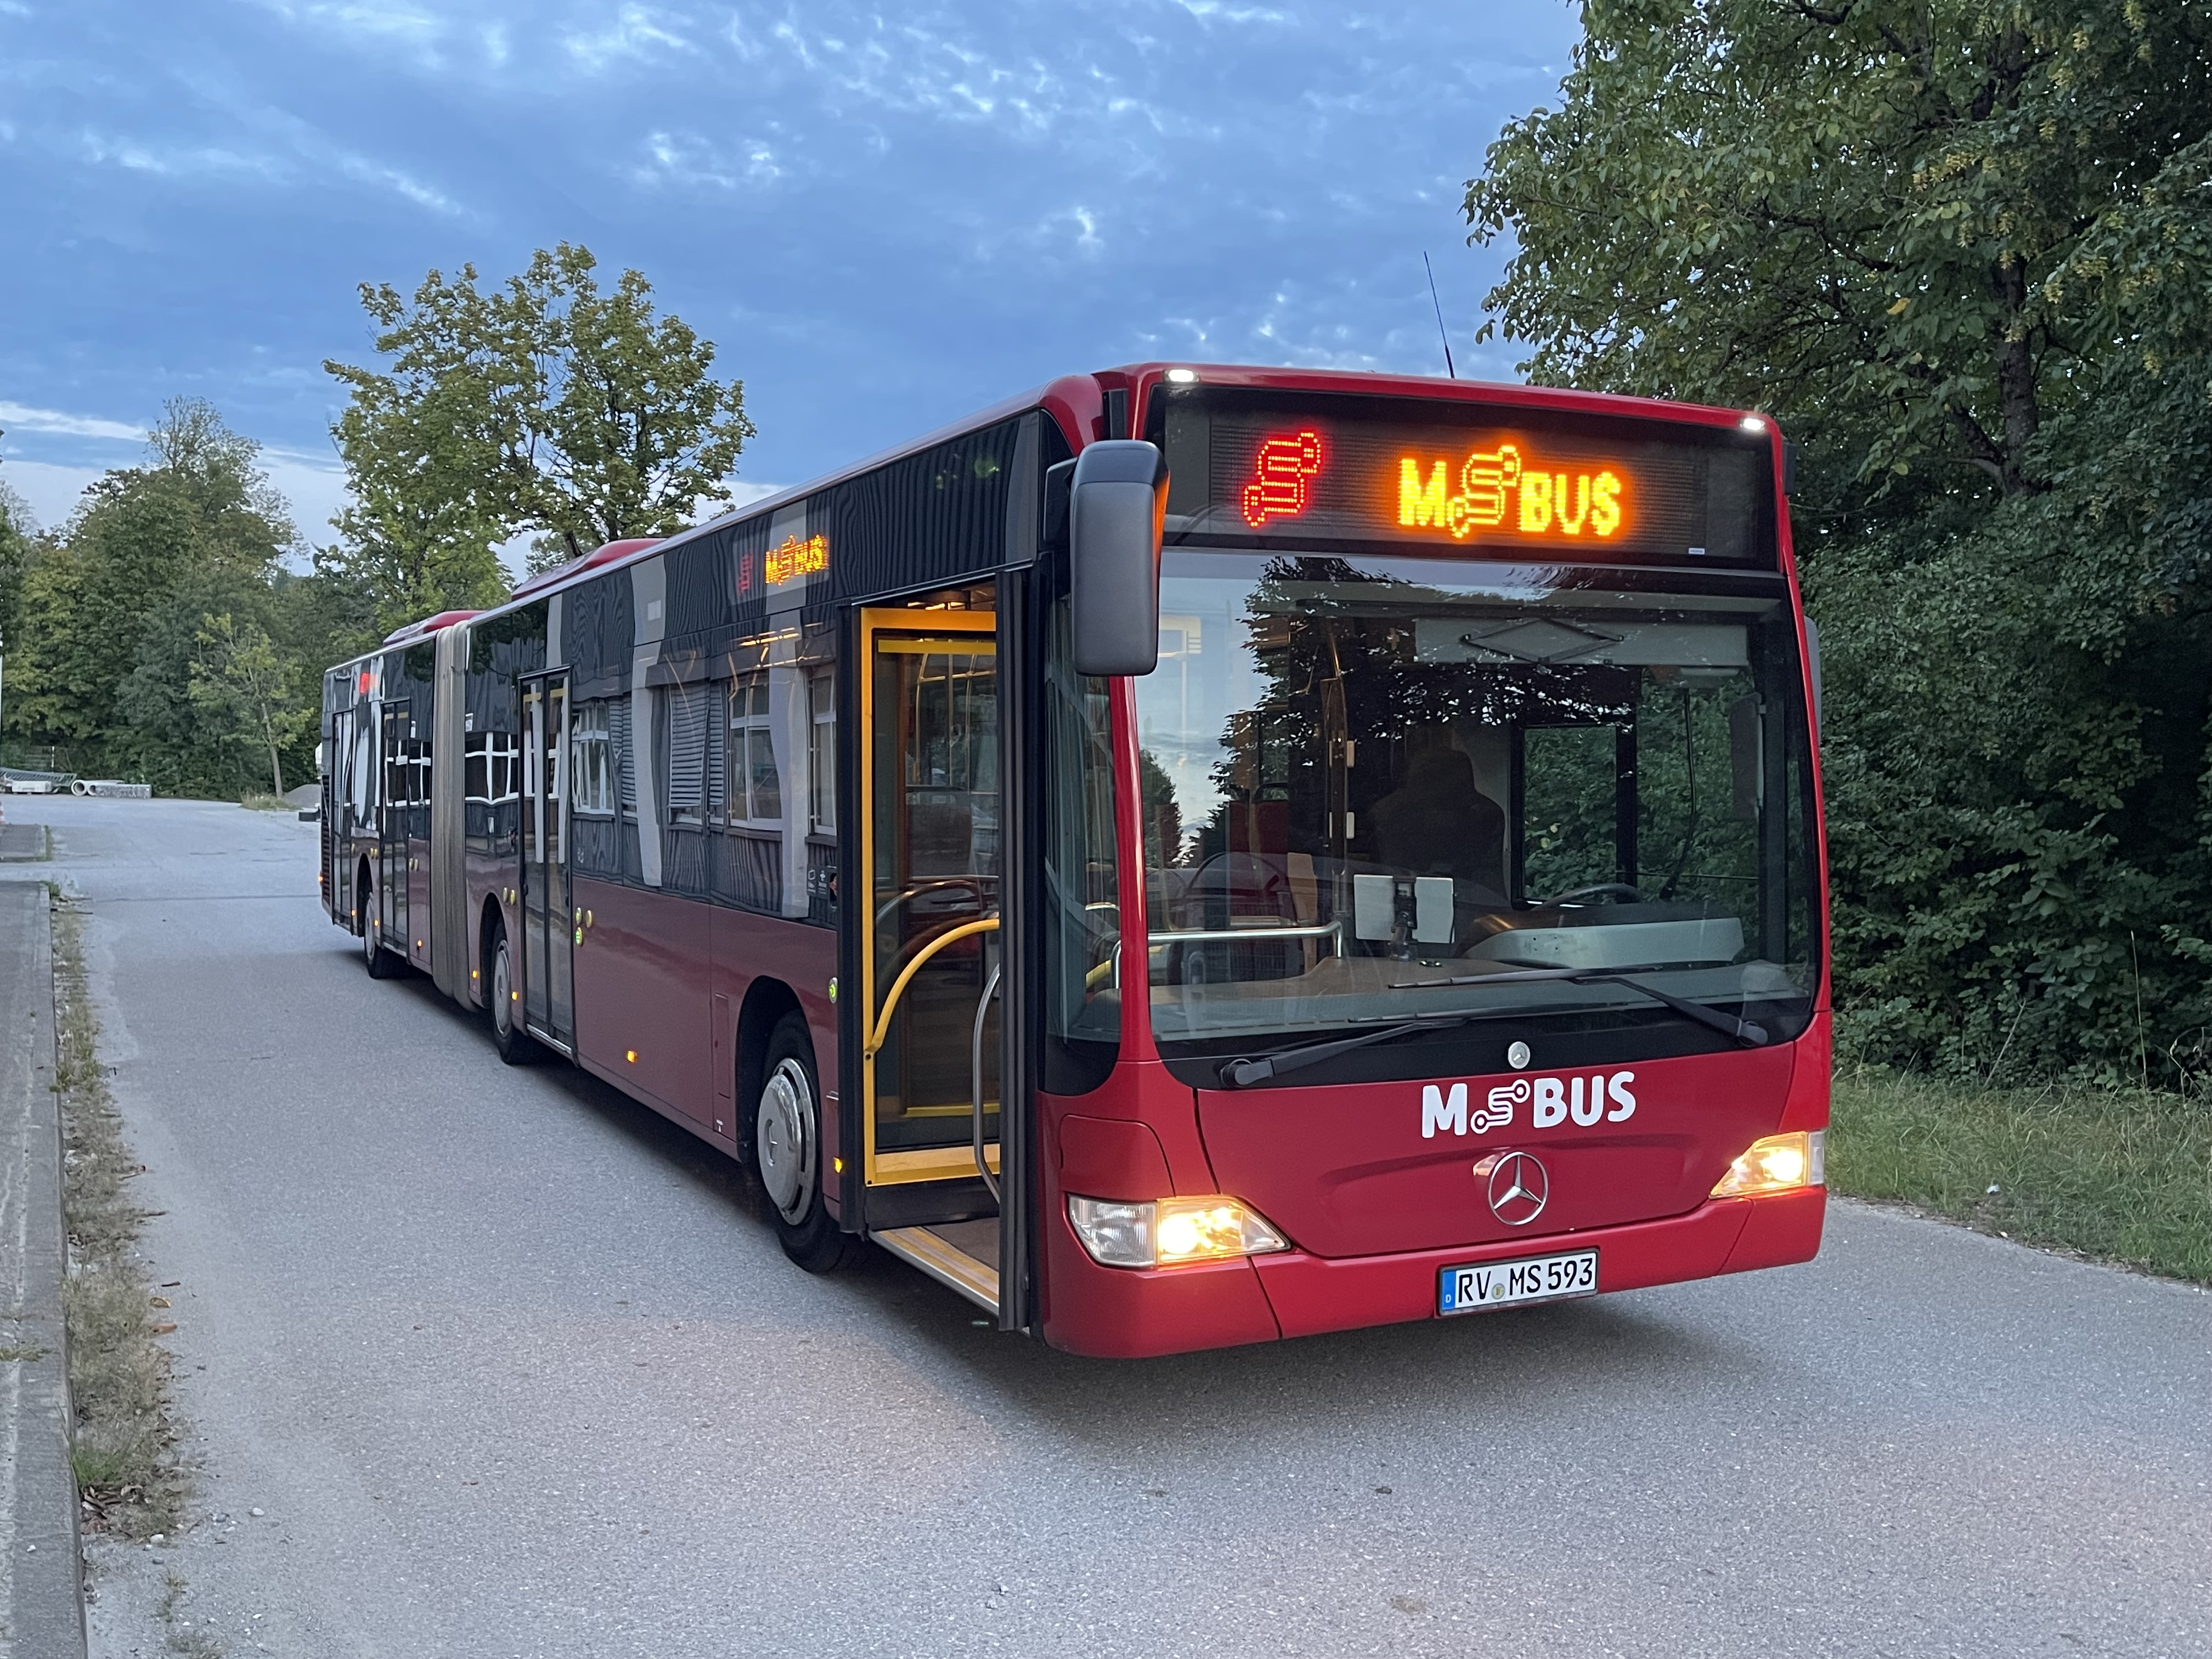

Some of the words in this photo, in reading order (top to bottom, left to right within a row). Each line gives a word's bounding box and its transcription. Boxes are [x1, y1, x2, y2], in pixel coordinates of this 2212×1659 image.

[1458, 1271, 1491, 1303] RV
[1509, 1265, 1541, 1296] MS
[1548, 1257, 1593, 1290] 593
[1445, 1294, 1452, 1304] D
